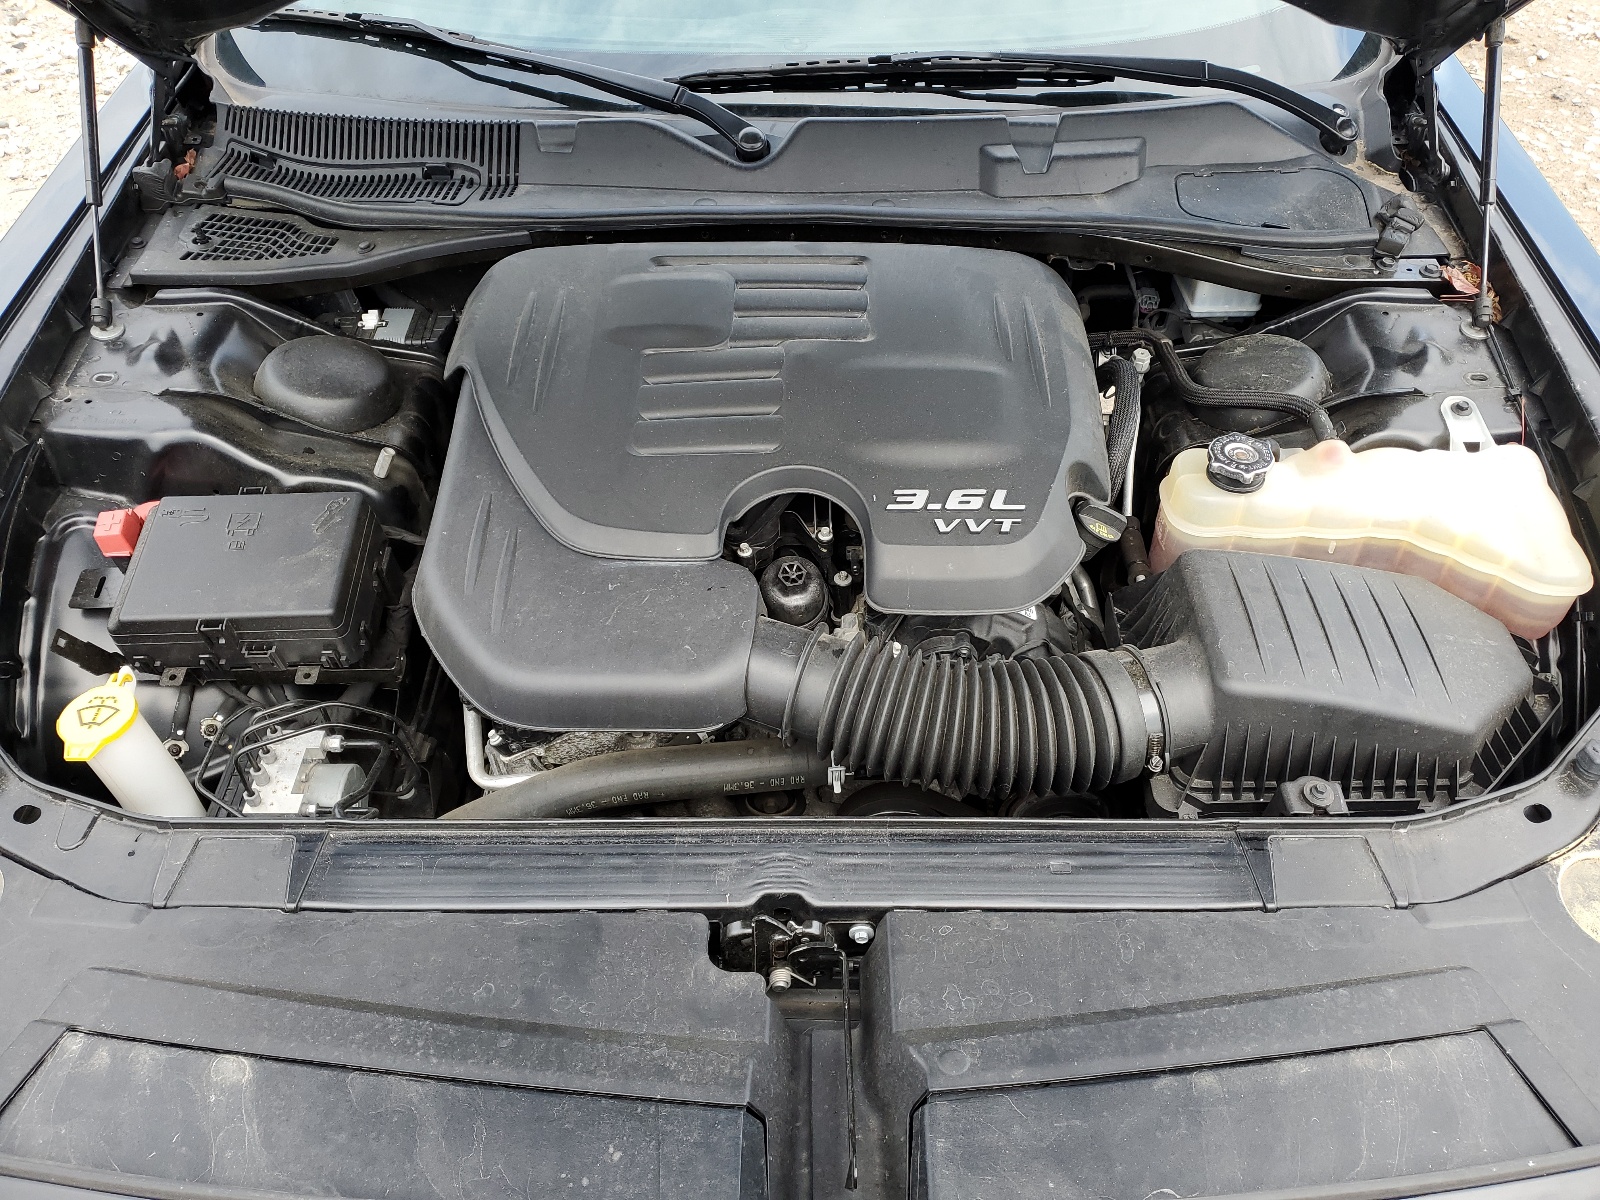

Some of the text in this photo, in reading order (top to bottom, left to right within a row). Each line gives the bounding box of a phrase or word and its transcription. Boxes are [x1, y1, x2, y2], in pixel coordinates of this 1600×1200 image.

[885, 488, 1026, 512] 3.6L
[934, 518, 1022, 534] VVT
[769, 777, 785, 787] END
[790, 775, 806, 785] RAD
